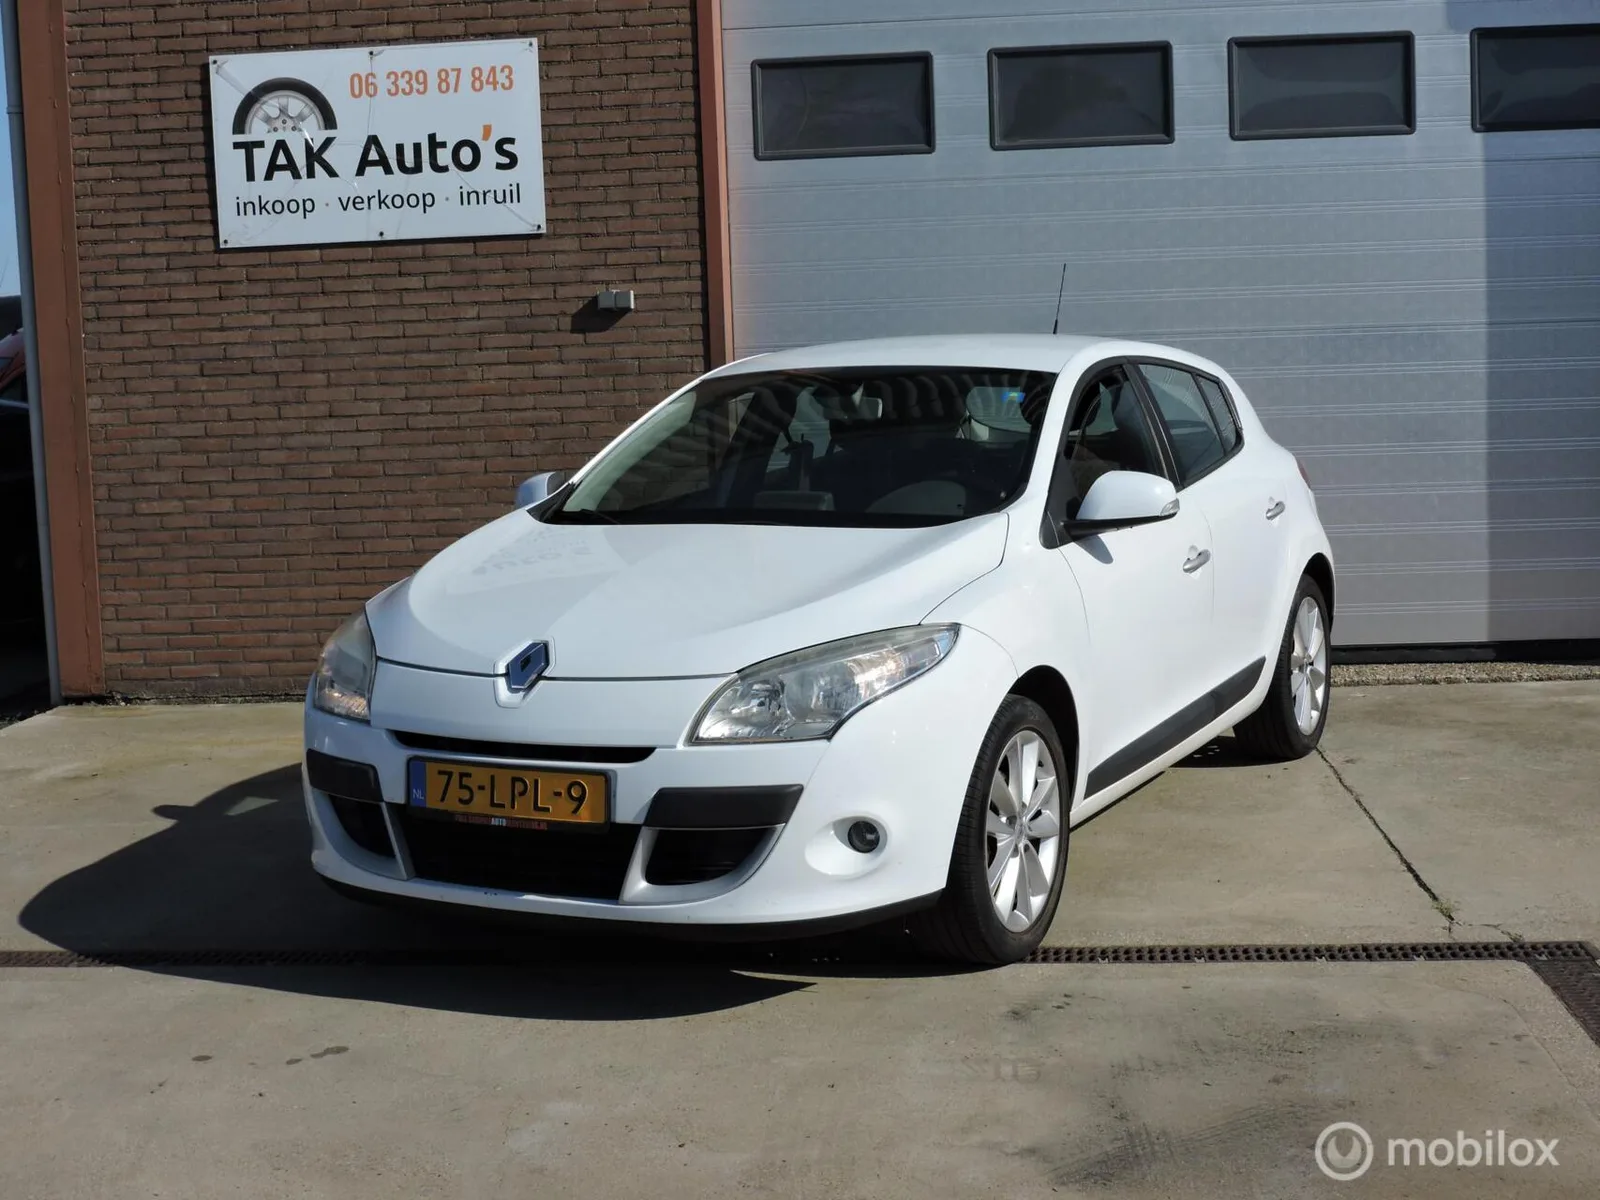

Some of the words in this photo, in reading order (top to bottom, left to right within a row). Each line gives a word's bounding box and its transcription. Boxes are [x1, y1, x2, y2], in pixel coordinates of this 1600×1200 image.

[350, 73, 378, 99] 06
[386, 69, 429, 97] 339
[437, 67, 462, 94] 87
[470, 64, 514, 92] 843
[232, 136, 339, 182] TAK
[355, 124, 519, 177] Auto's
[236, 194, 316, 219] inkoop
[338, 189, 436, 214] verkoop
[459, 183, 521, 206] inruil
[412, 788, 424, 800] NL
[438, 770, 589, 815] 75-LPL-9
